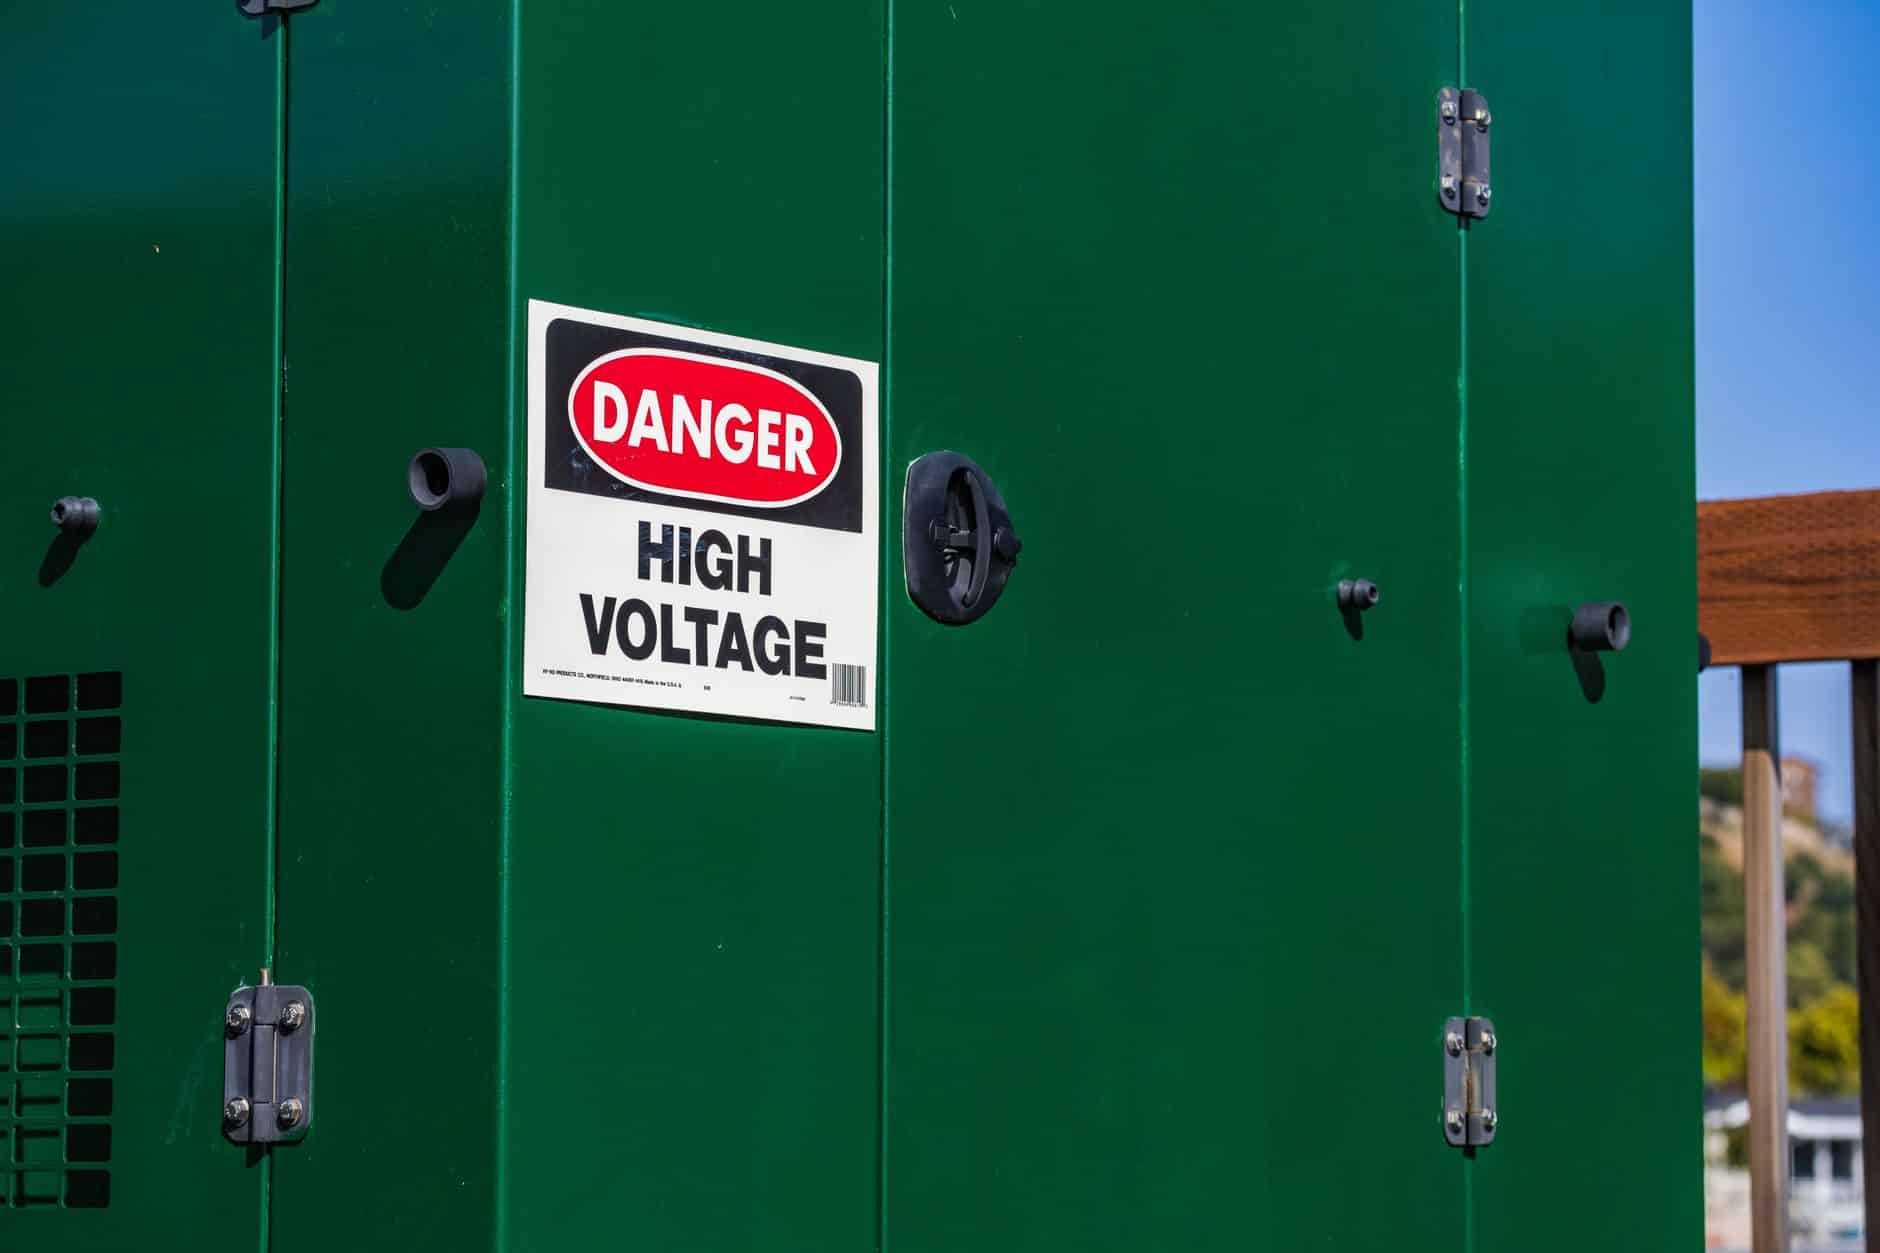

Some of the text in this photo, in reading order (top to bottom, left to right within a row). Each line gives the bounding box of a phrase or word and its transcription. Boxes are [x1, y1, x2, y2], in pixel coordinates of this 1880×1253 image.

[593, 380, 817, 476] DANGER
[638, 520, 772, 597] HIGH
[579, 592, 828, 681] VOLTAGE
